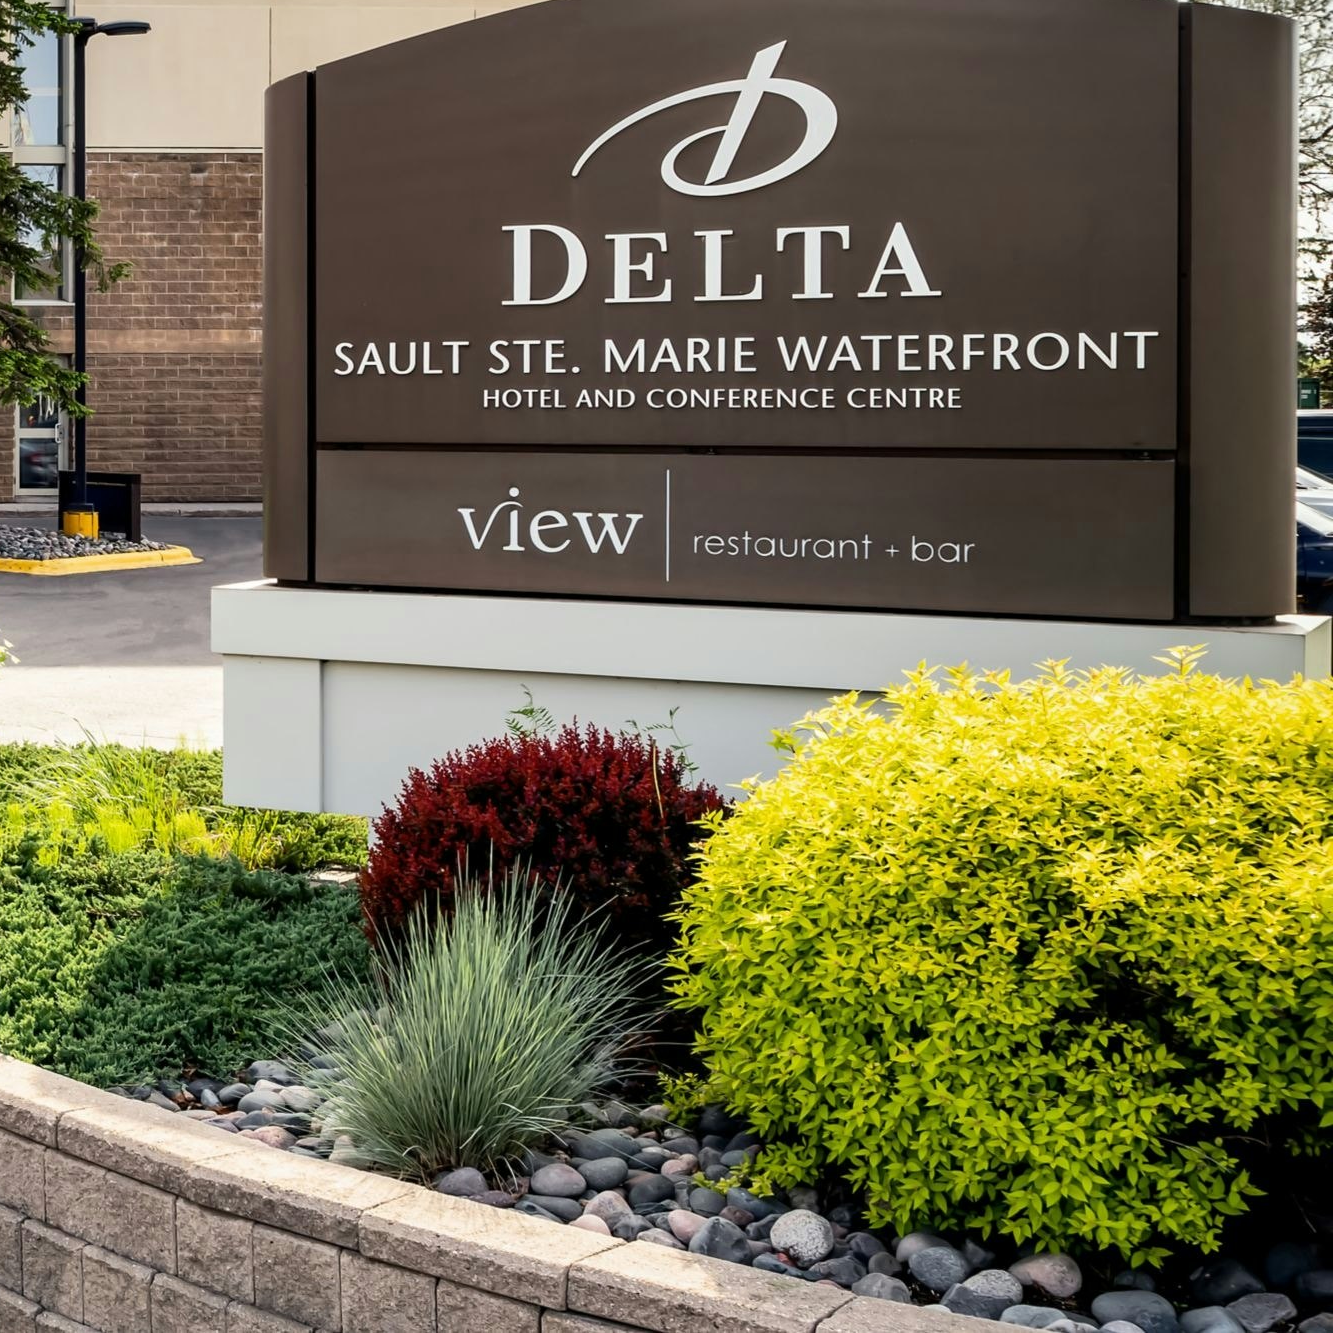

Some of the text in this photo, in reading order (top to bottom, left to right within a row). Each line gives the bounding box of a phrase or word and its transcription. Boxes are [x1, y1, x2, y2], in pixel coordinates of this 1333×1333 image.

[500, 221, 942, 306] DELTA
[334, 330, 1159, 376] SAULT STE. MARIE WATERFRONT
[482, 387, 963, 409] HOTEL AND CONFERENCE CENTRE
[457, 487, 644, 555] view
[693, 530, 873, 560] restaurant
[911, 535, 976, 564] bar
